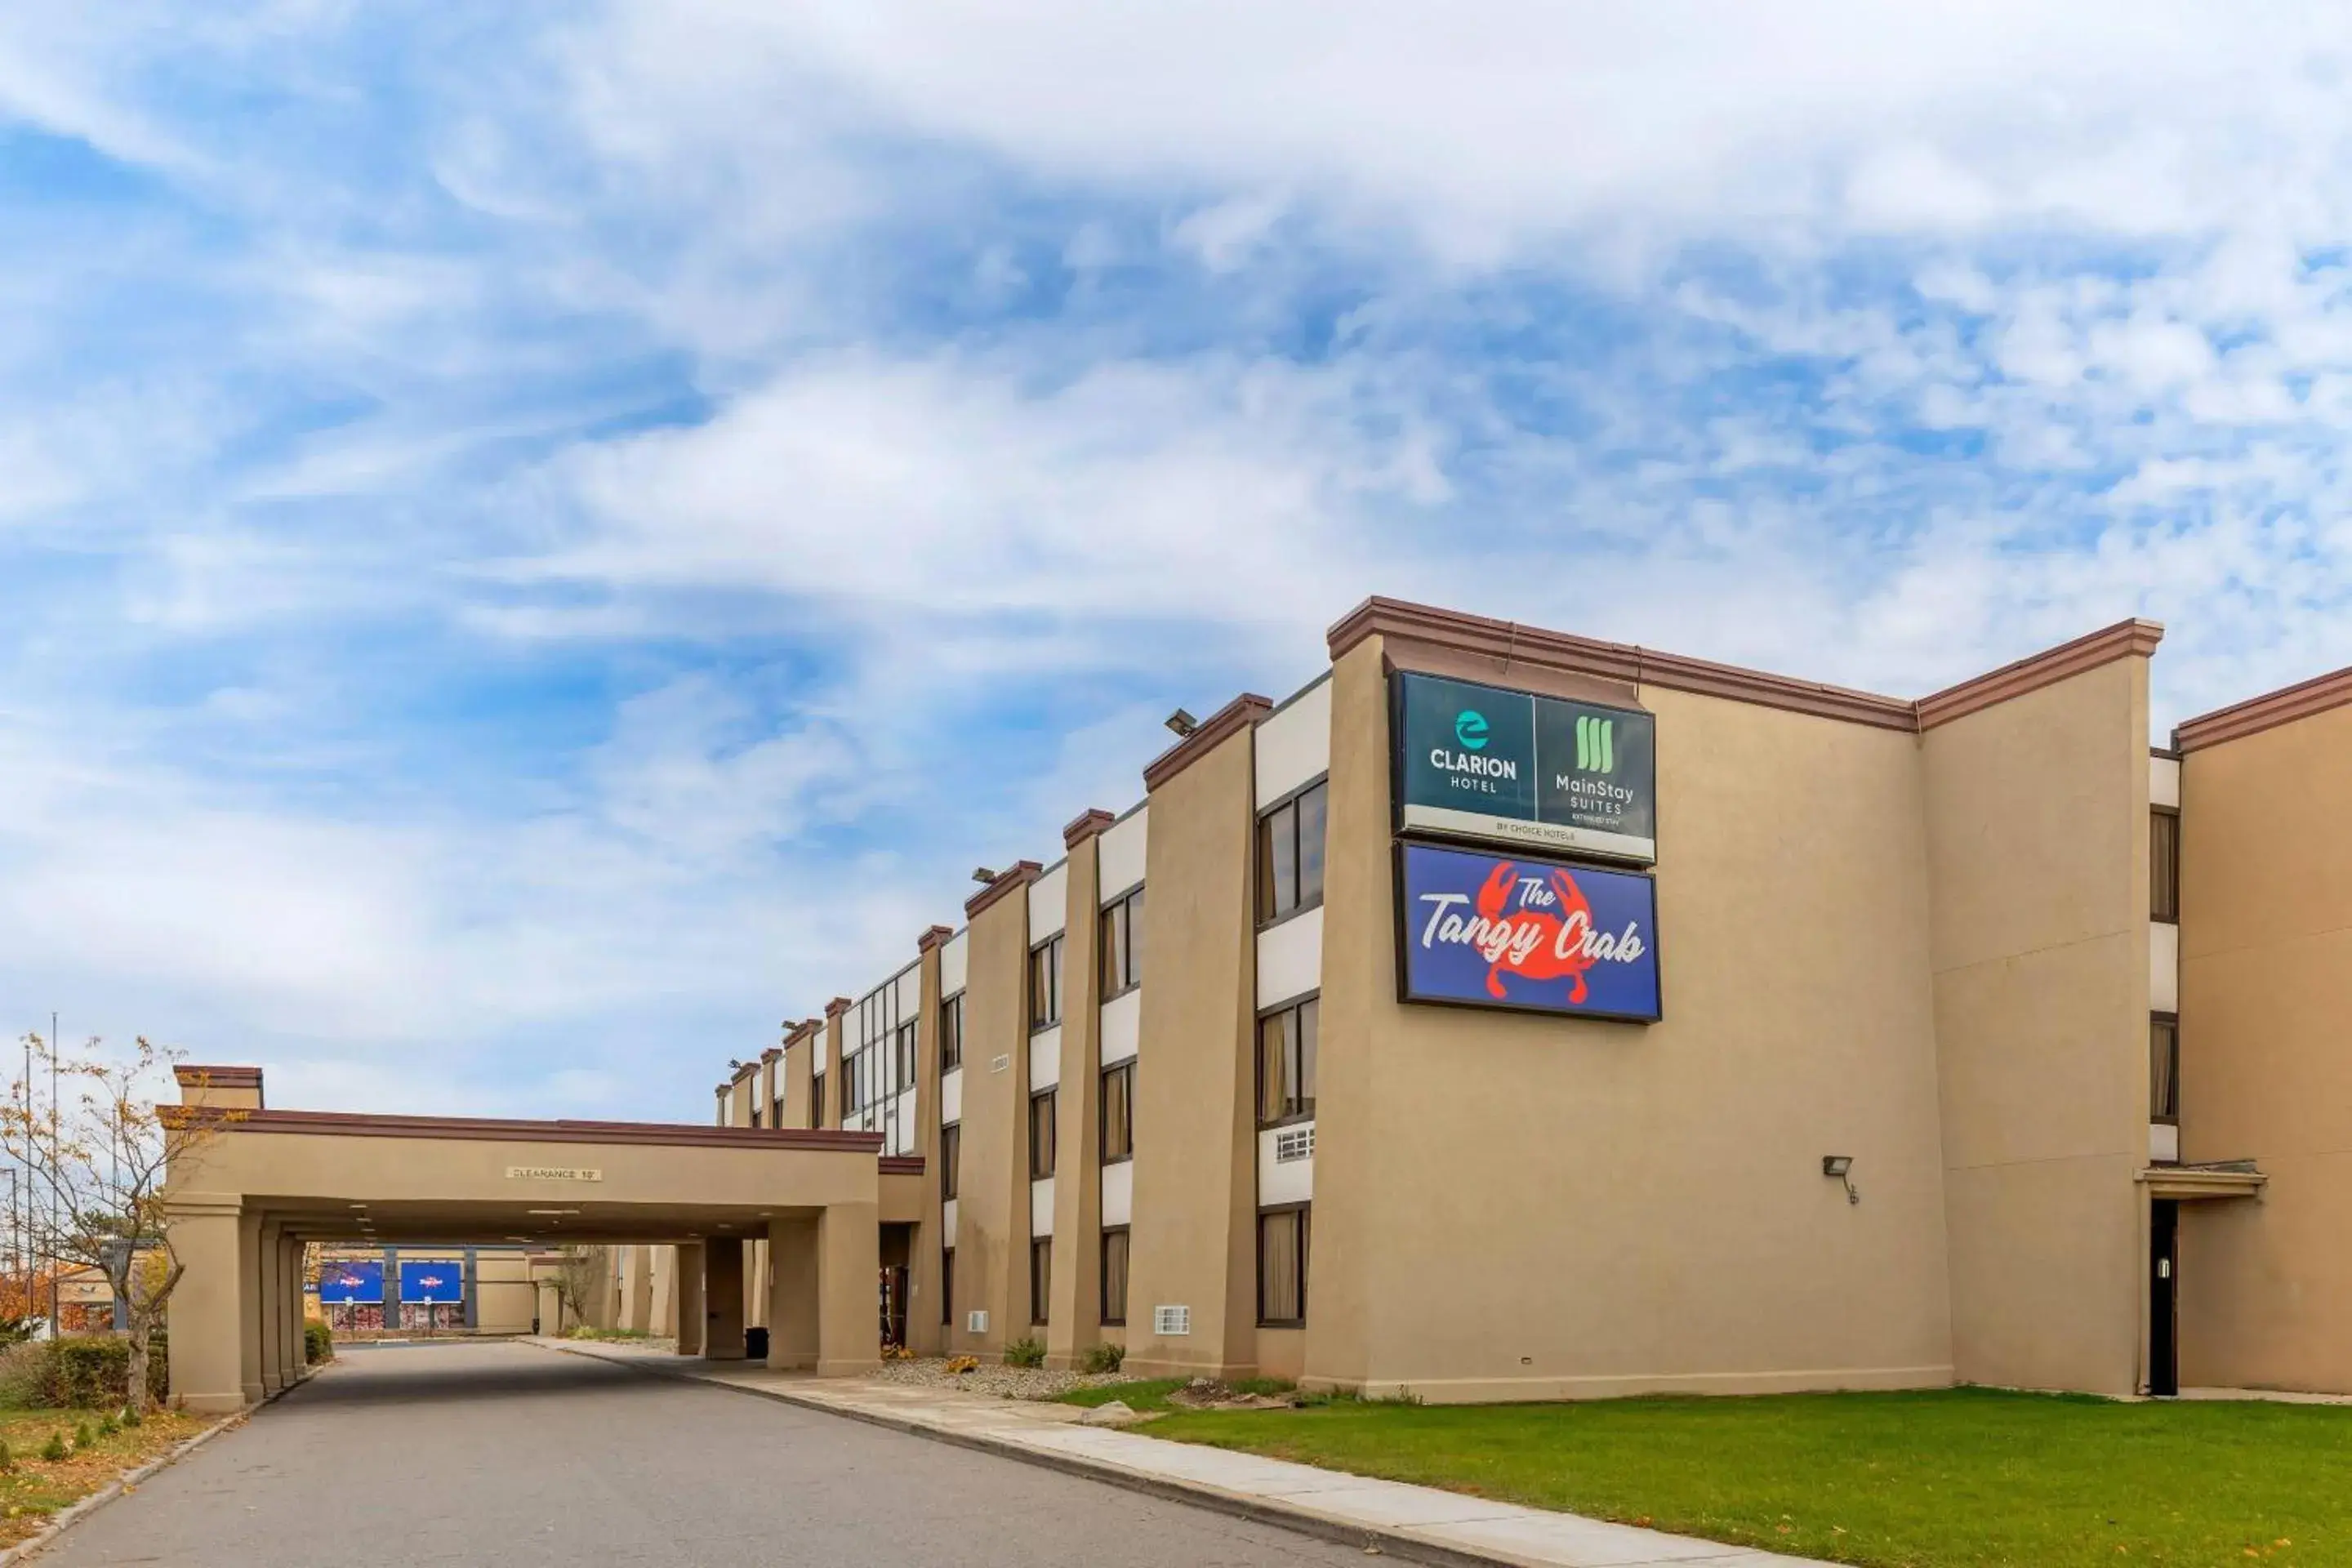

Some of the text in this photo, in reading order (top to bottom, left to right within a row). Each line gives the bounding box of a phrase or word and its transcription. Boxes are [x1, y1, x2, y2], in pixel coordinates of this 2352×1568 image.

[1430, 749, 1517, 781] CLARION
[1451, 776, 1497, 795] HOTEL
[1555, 773, 1633, 804] MainStay
[1570, 795, 1621, 815] SUITES
[1496, 822, 1575, 841] BY CHOICE HOTELS
[1517, 877, 1557, 907] The
[1419, 893, 1646, 966] Tangy Crab
[513, 1169, 576, 1178] CLEARANCE
